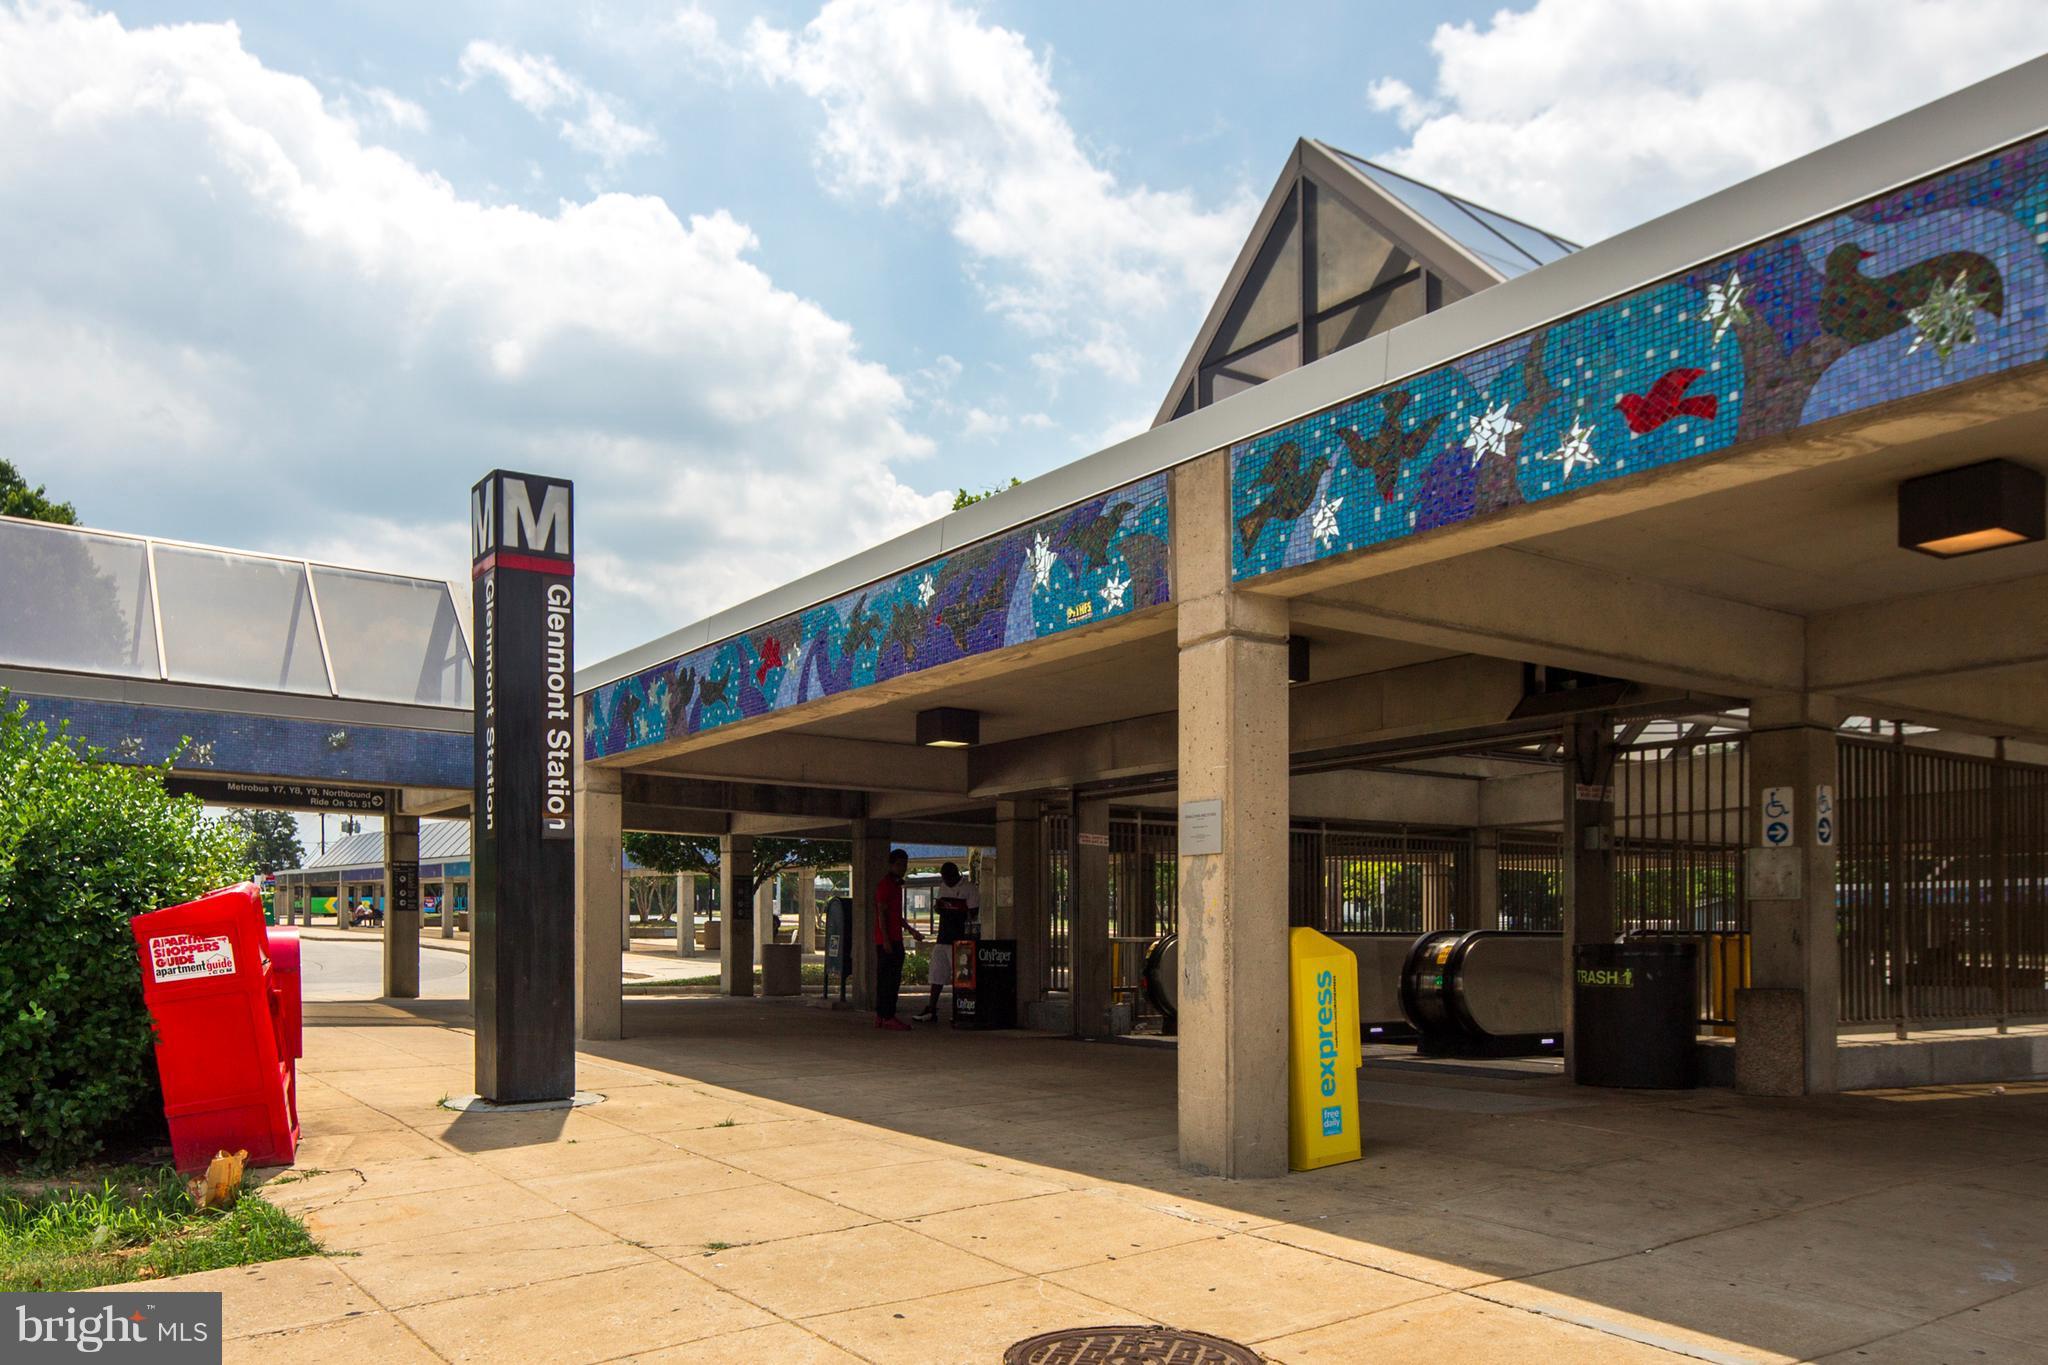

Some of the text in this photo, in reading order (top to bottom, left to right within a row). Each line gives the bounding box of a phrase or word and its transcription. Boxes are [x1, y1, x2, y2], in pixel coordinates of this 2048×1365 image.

[472, 478, 494, 559] M
[503, 477, 569, 555] M
[485, 579, 495, 830] Glenmont Station
[547, 583, 571, 830] Glenmont Station
[227, 783, 269, 793] Metrobus
[322, 788, 371, 799] Northbound
[310, 797, 329, 806] Ride
[332, 799, 345, 807] On
[154, 942, 220, 958] SHOPPERS
[155, 954, 195, 968] GUIDE
[1577, 969, 1618, 985] TRASH
[1317, 970, 1338, 1097] express
[1323, 1109, 1340, 1119] free
[1323, 1116, 1342, 1129] daily
